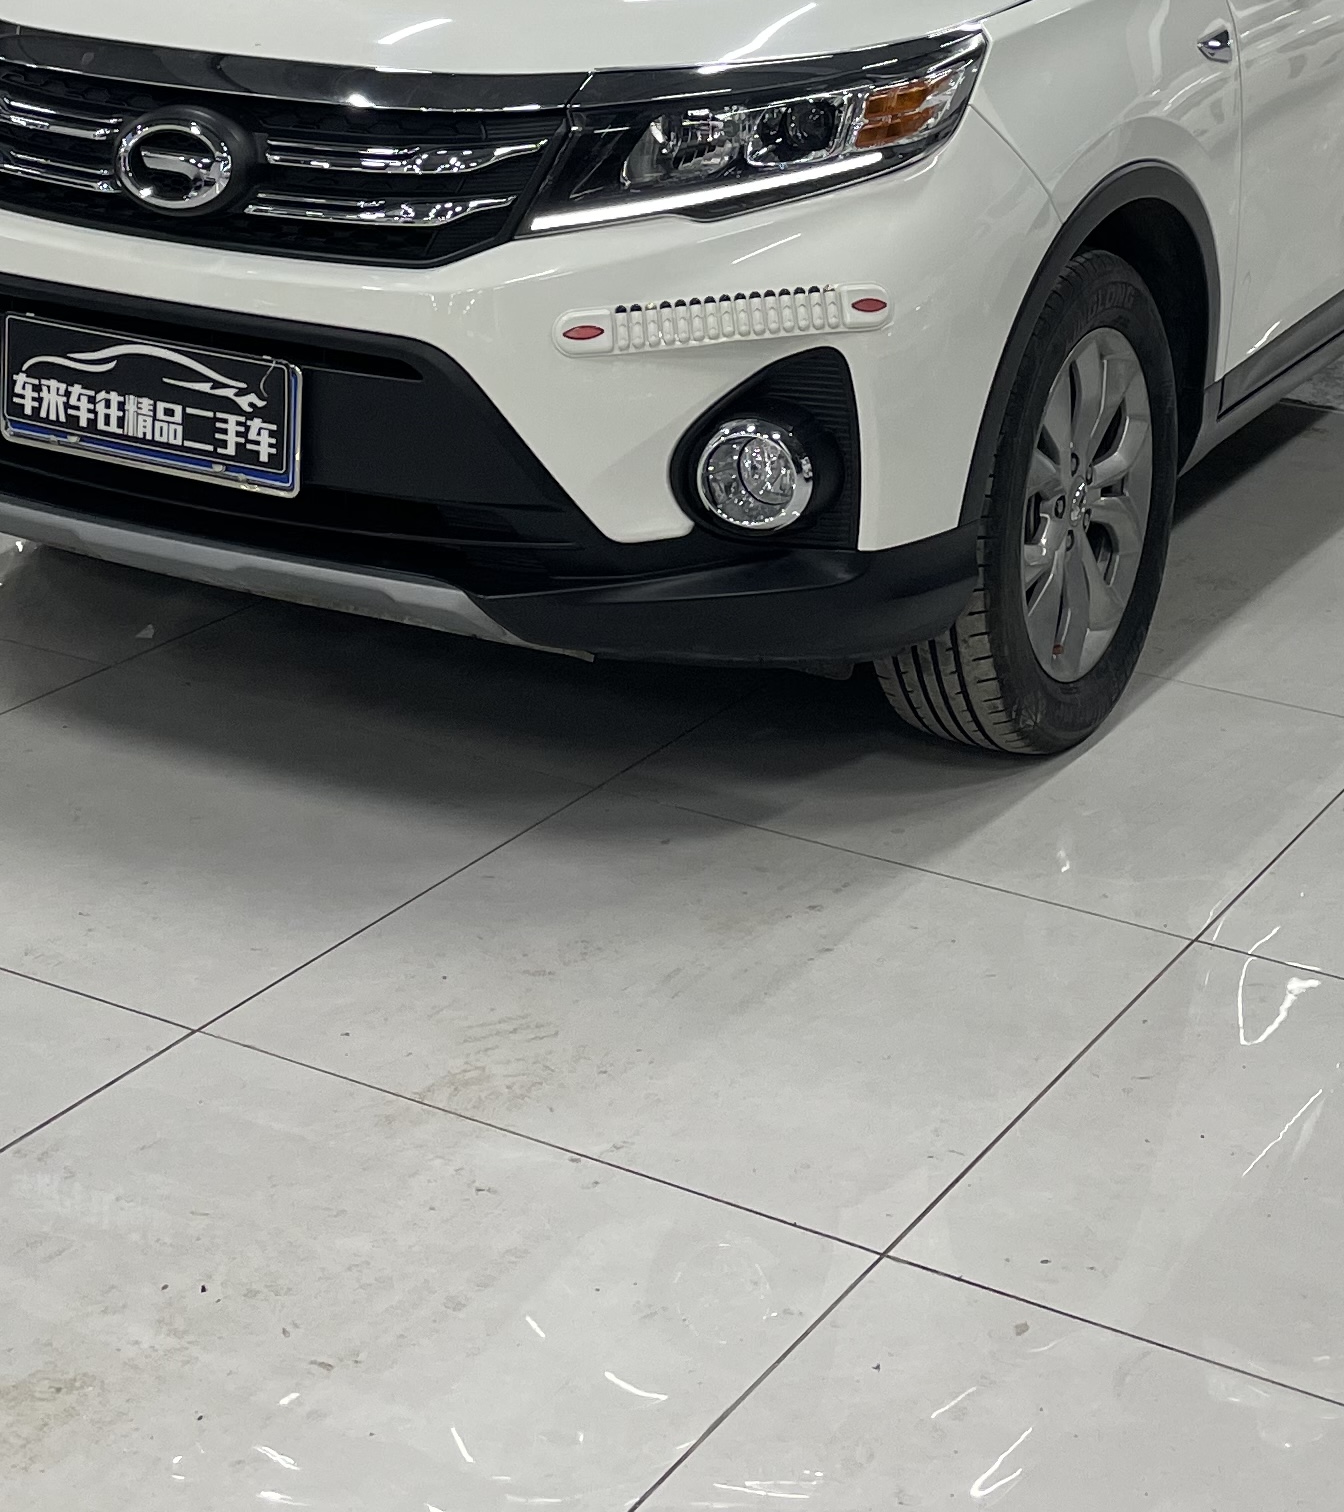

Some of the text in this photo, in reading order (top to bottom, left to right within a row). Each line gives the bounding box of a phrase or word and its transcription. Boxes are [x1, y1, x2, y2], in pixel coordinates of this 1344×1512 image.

[12, 372, 278, 463] 车来车往精品二手车
